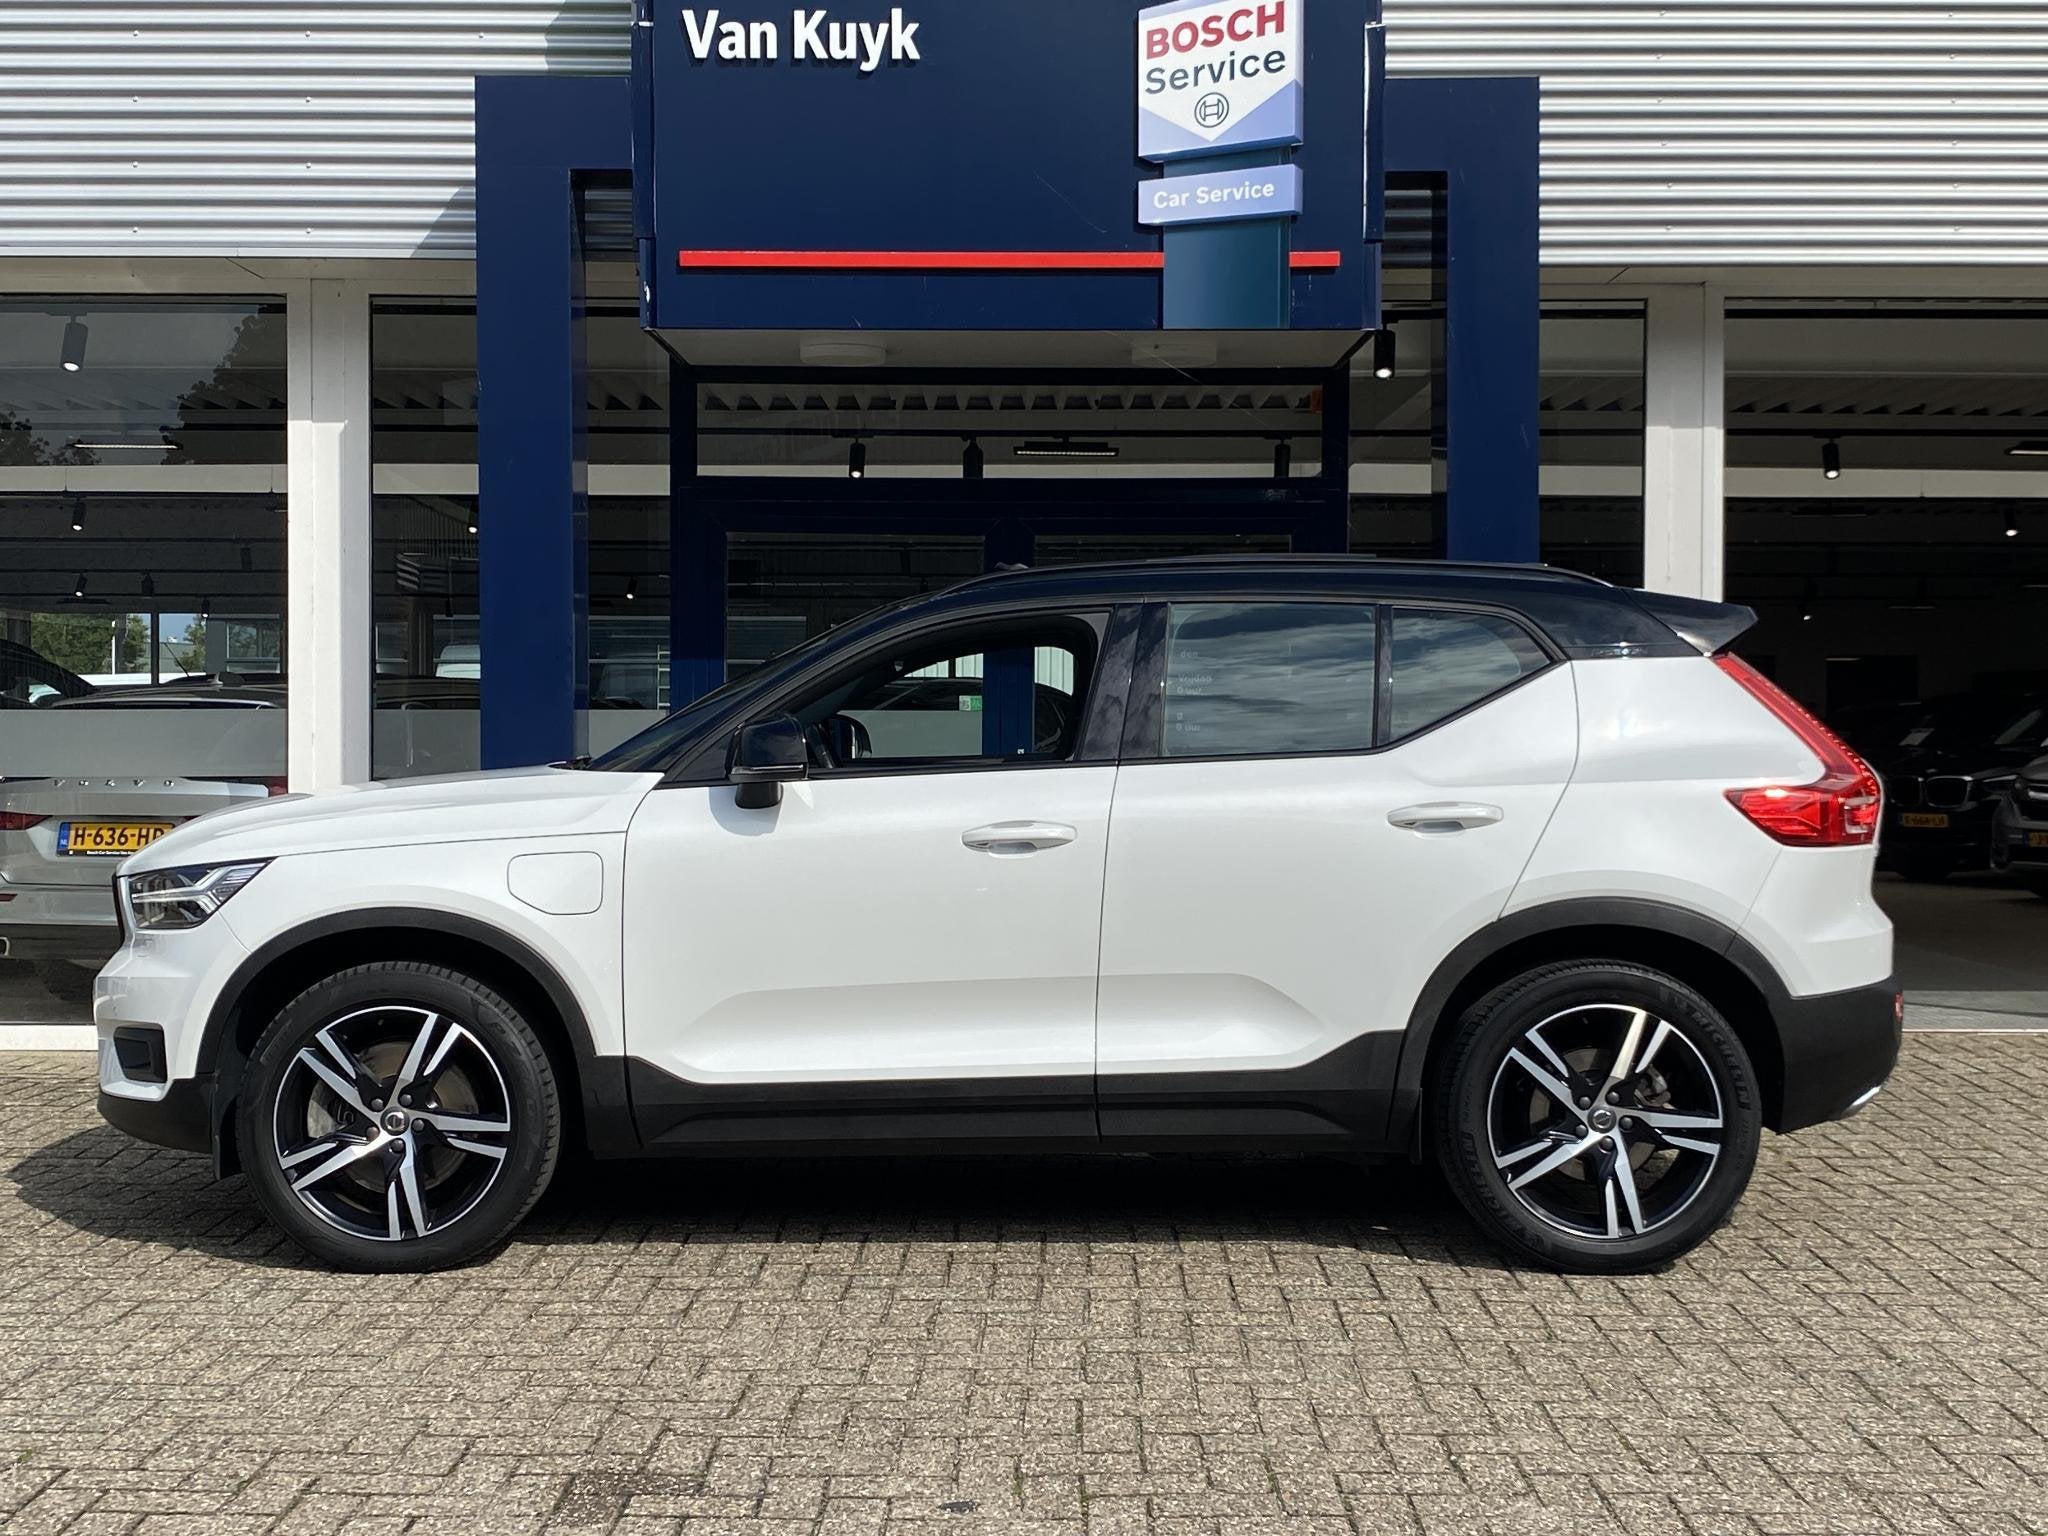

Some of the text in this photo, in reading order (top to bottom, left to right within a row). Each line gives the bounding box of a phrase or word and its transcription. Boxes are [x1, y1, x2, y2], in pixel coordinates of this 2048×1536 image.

[682, 8, 920, 72] Van Kuyk
[1146, 1, 1285, 60] BOSCH
[1145, 50, 1286, 94] Service
[1154, 181, 1275, 208] Car Service
